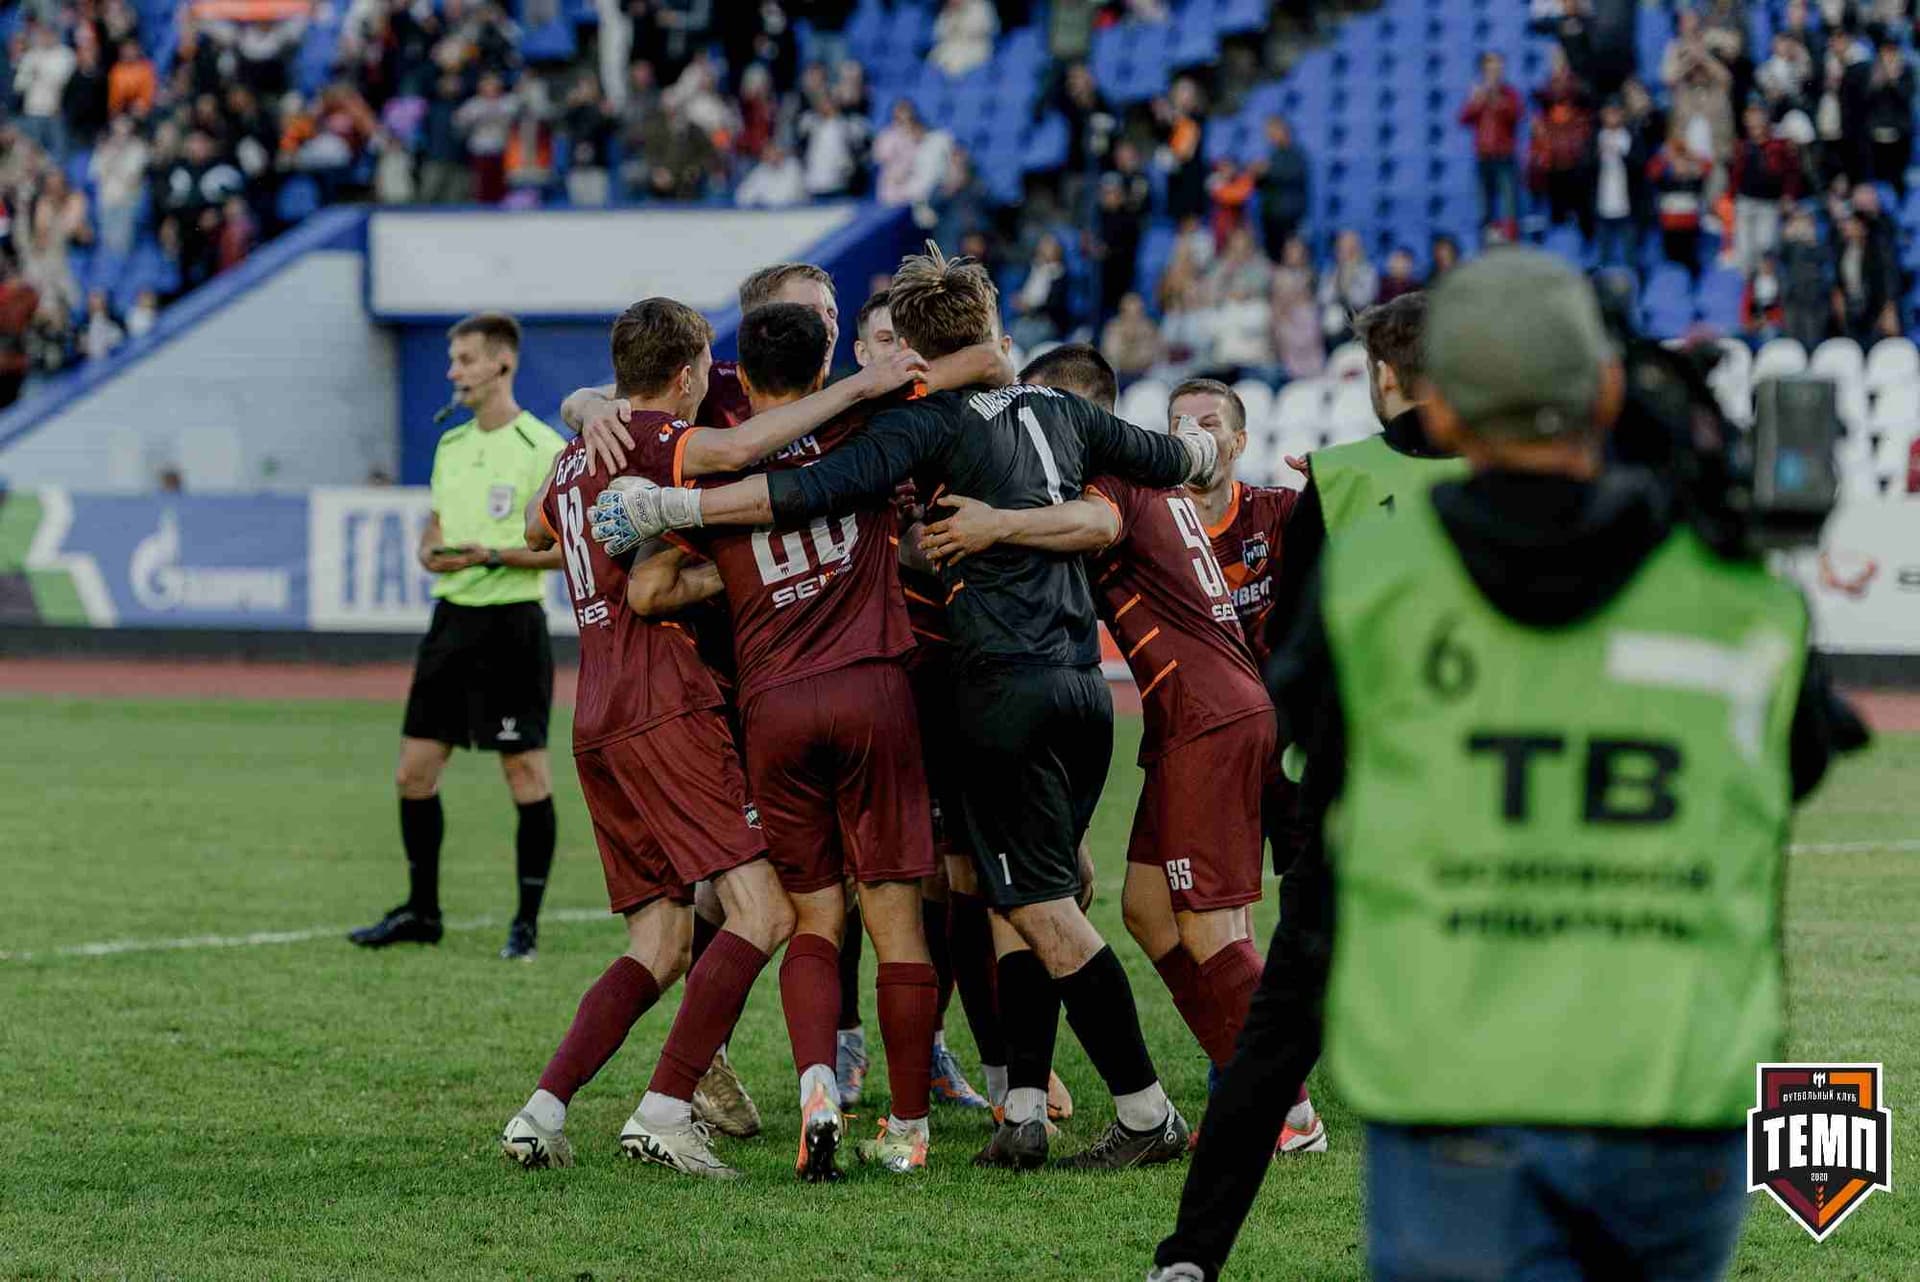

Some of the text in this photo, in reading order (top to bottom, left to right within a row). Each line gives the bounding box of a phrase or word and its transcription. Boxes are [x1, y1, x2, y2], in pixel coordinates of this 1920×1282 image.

[1017, 405, 1064, 505] 1
[1166, 497, 1232, 598] 5
[1422, 607, 1478, 703] 6
[1465, 733, 1683, 824] ТВ
[998, 852, 1012, 886] 1
[1166, 857, 1194, 890] 55
